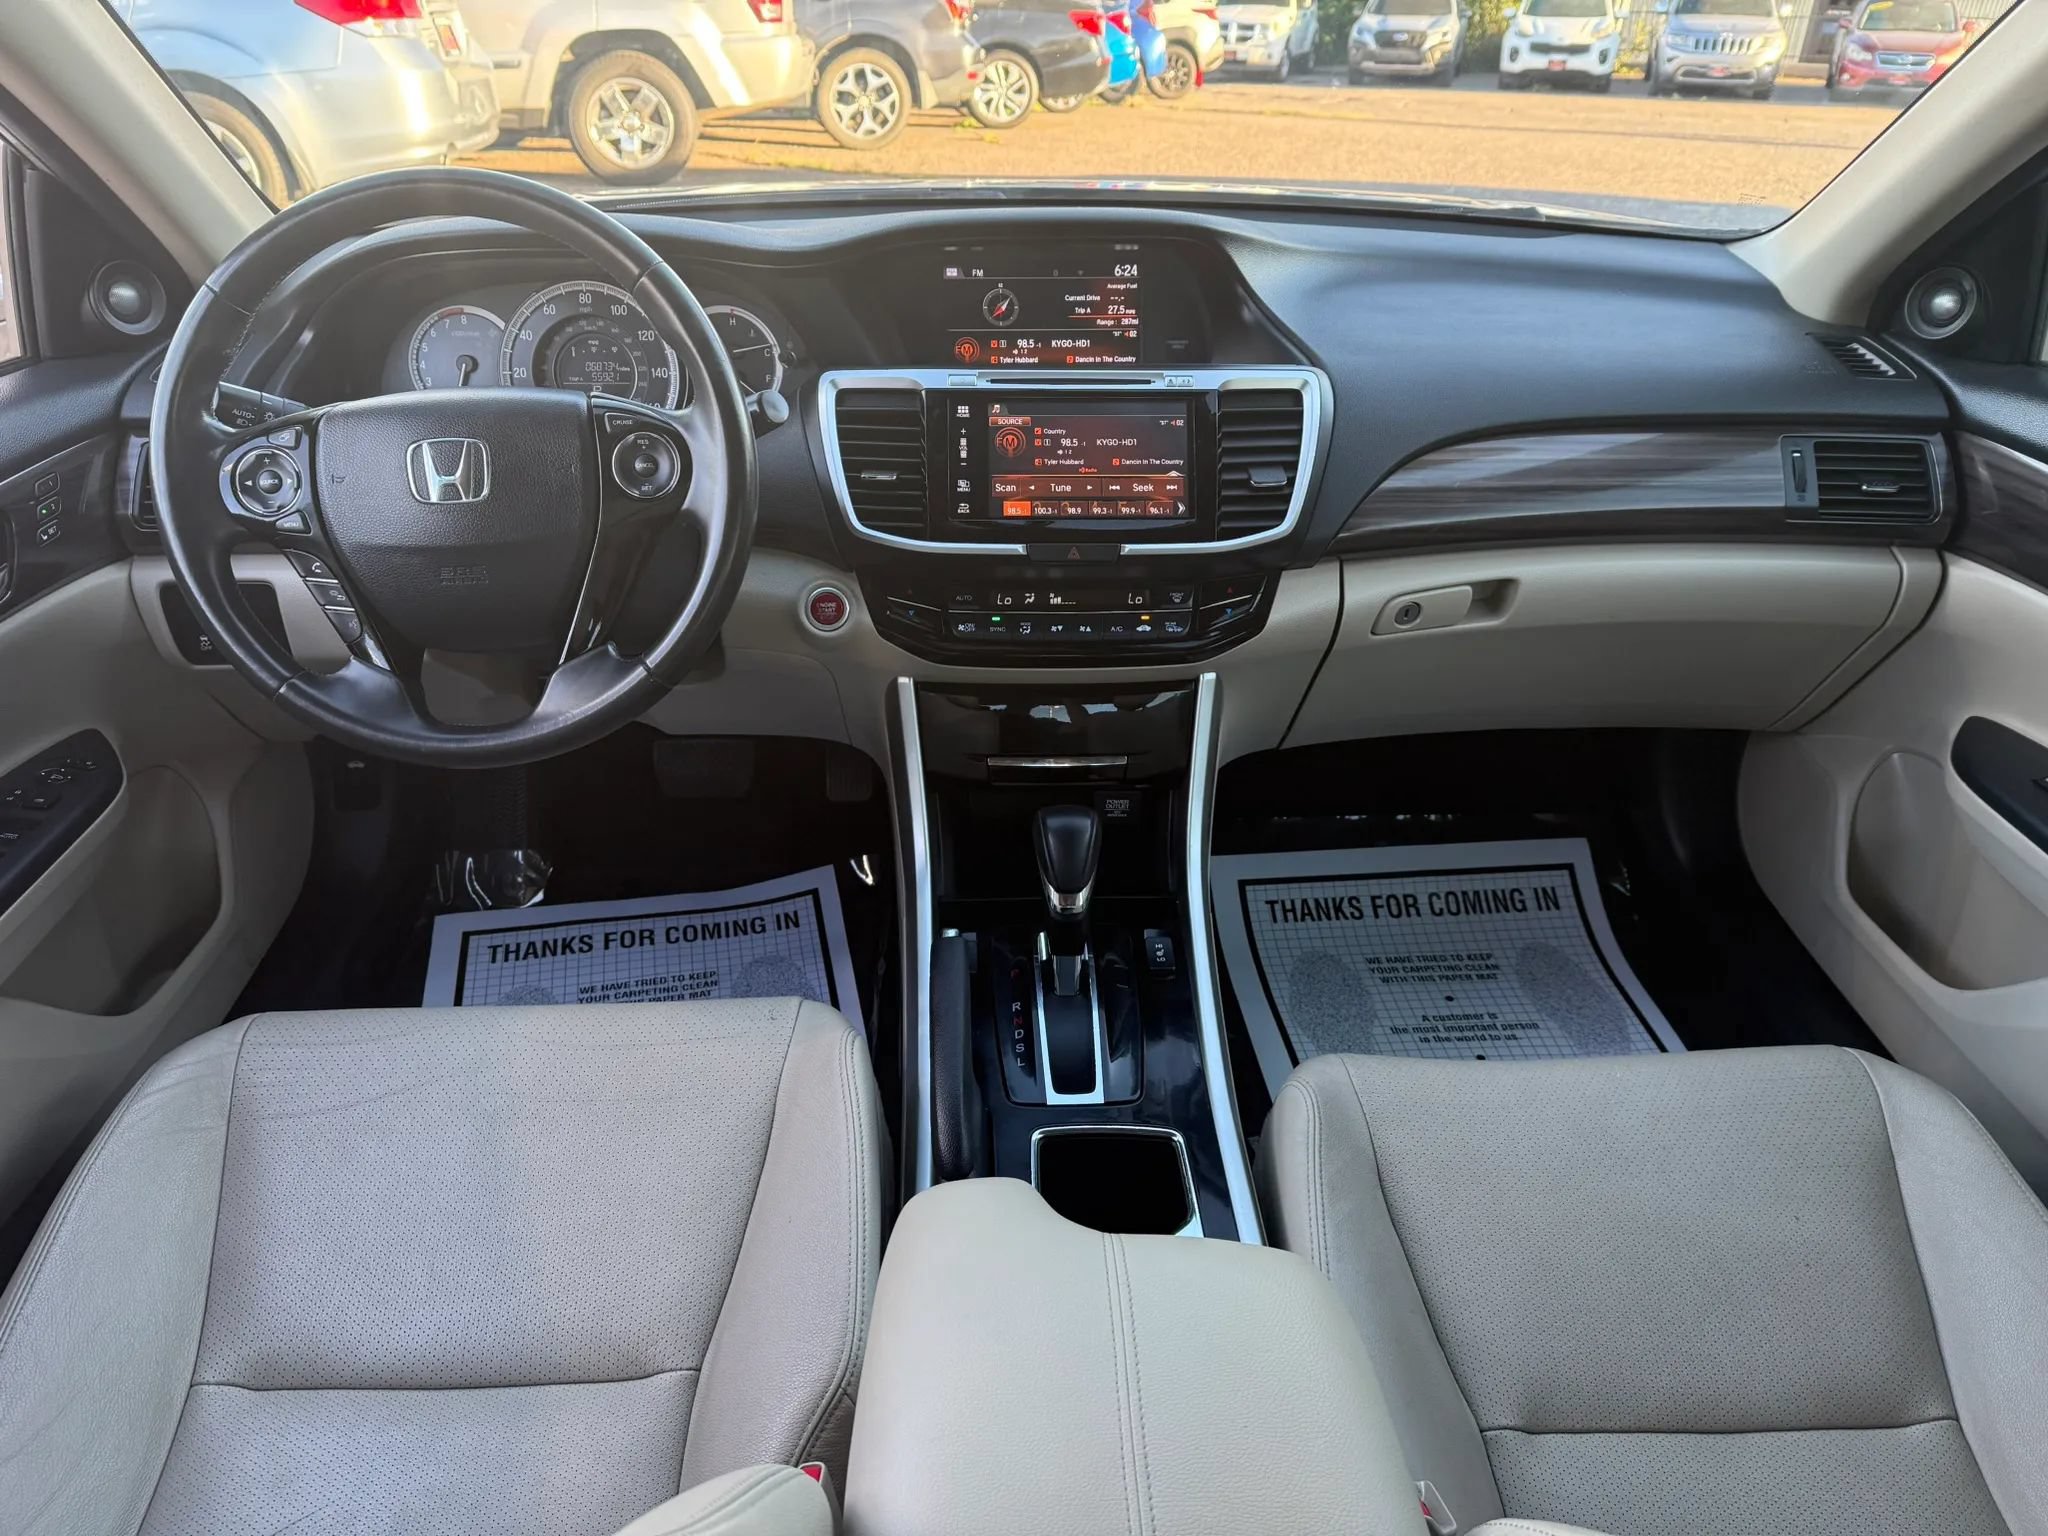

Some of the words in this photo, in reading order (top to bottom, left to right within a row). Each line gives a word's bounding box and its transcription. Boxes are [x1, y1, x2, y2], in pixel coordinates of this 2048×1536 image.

[972, 269, 984, 277] FM
[1114, 264, 1138, 277] 6:24
[578, 293, 592, 304] 80
[543, 304, 556, 315] 60
[610, 305, 628, 316] 100
[1107, 305, 1125, 315] 27.5
[444, 319, 449, 329] 7
[461, 315, 467, 325] 8
[729, 317, 736, 326] H
[430, 328, 436, 337] 6
[519, 330, 532, 341] 40
[638, 330, 655, 341] 120
[422, 343, 428, 352] 5
[1017, 340, 1034, 348] 98.5
[764, 348, 770, 356] C
[420, 360, 425, 369] 4
[1000, 356, 1013, 364] Tyler
[1114, 355, 1136, 364] Country
[513, 368, 527, 378] 20
[652, 368, 668, 378] 140
[426, 377, 431, 386] 3
[766, 375, 771, 383] F
[231, 408, 253, 418] AUTO
[1044, 428, 1066, 436] Country
[1061, 438, 1078, 446] 98.5
[1096, 438, 1137, 446] KYGO-HD1
[1044, 458, 1058, 466] Tyler
[1162, 458, 1184, 466] Country
[995, 483, 1016, 492] Scan
[1050, 484, 1071, 492] Tune
[1132, 483, 1154, 492] Seek
[1067, 507, 1081, 515] 98.9
[1093, 507, 1107, 515] 99.3
[1121, 507, 1135, 515] 99.9
[997, 593, 1012, 605] Lo
[1128, 593, 1143, 605] Lo
[1265, 896, 1364, 923] THANKS
[1370, 894, 1421, 919] FOR
[1428, 888, 1527, 917] COMING
[1533, 886, 1560, 911] IN
[487, 934, 594, 964] THANKS
[603, 929, 655, 950] FOR
[665, 916, 766, 944] COMING
[775, 910, 800, 931] IN
[1385, 955, 1413, 963] HAVE
[1415, 954, 1446, 963] TRIED
[1450, 954, 1464, 962] TO
[1466, 953, 1493, 961] KEEP
[1368, 966, 1400, 974] YOUR
[1402, 964, 1462, 973] CARPETING
[1464, 963, 1500, 971] CLEAN
[580, 985, 598, 994] WE
[600, 981, 631, 992] HAVE
[634, 976, 667, 987] TRIED
[669, 974, 685, 982] TO
[688, 970, 716, 980] KEEP
[1437, 973, 1473, 981] PAPER
[578, 994, 610, 1004] YOUR
[614, 985, 678, 1000] CARPETING
[682, 980, 718, 991] CLEAN
[688, 989, 712, 999] MAT
[1012, 1002, 1021, 1012] R
[1013, 1016, 1022, 1026] N
[1432, 1013, 1485, 1022] customer
[1489, 1012, 1498, 1020] is
[1390, 1025, 1408, 1034] the
[1412, 1024, 1440, 1033] most
[1443, 1022, 1499, 1034] important
[1501, 1022, 1540, 1032] person
[1015, 1030, 1024, 1039] D
[1419, 1035, 1430, 1043] in
[1433, 1034, 1451, 1043] the
[1454, 1033, 1487, 1043] world
[1489, 1033, 1500, 1041] to
[1016, 1043, 1024, 1052] S
[1017, 1057, 1025, 1066] L
